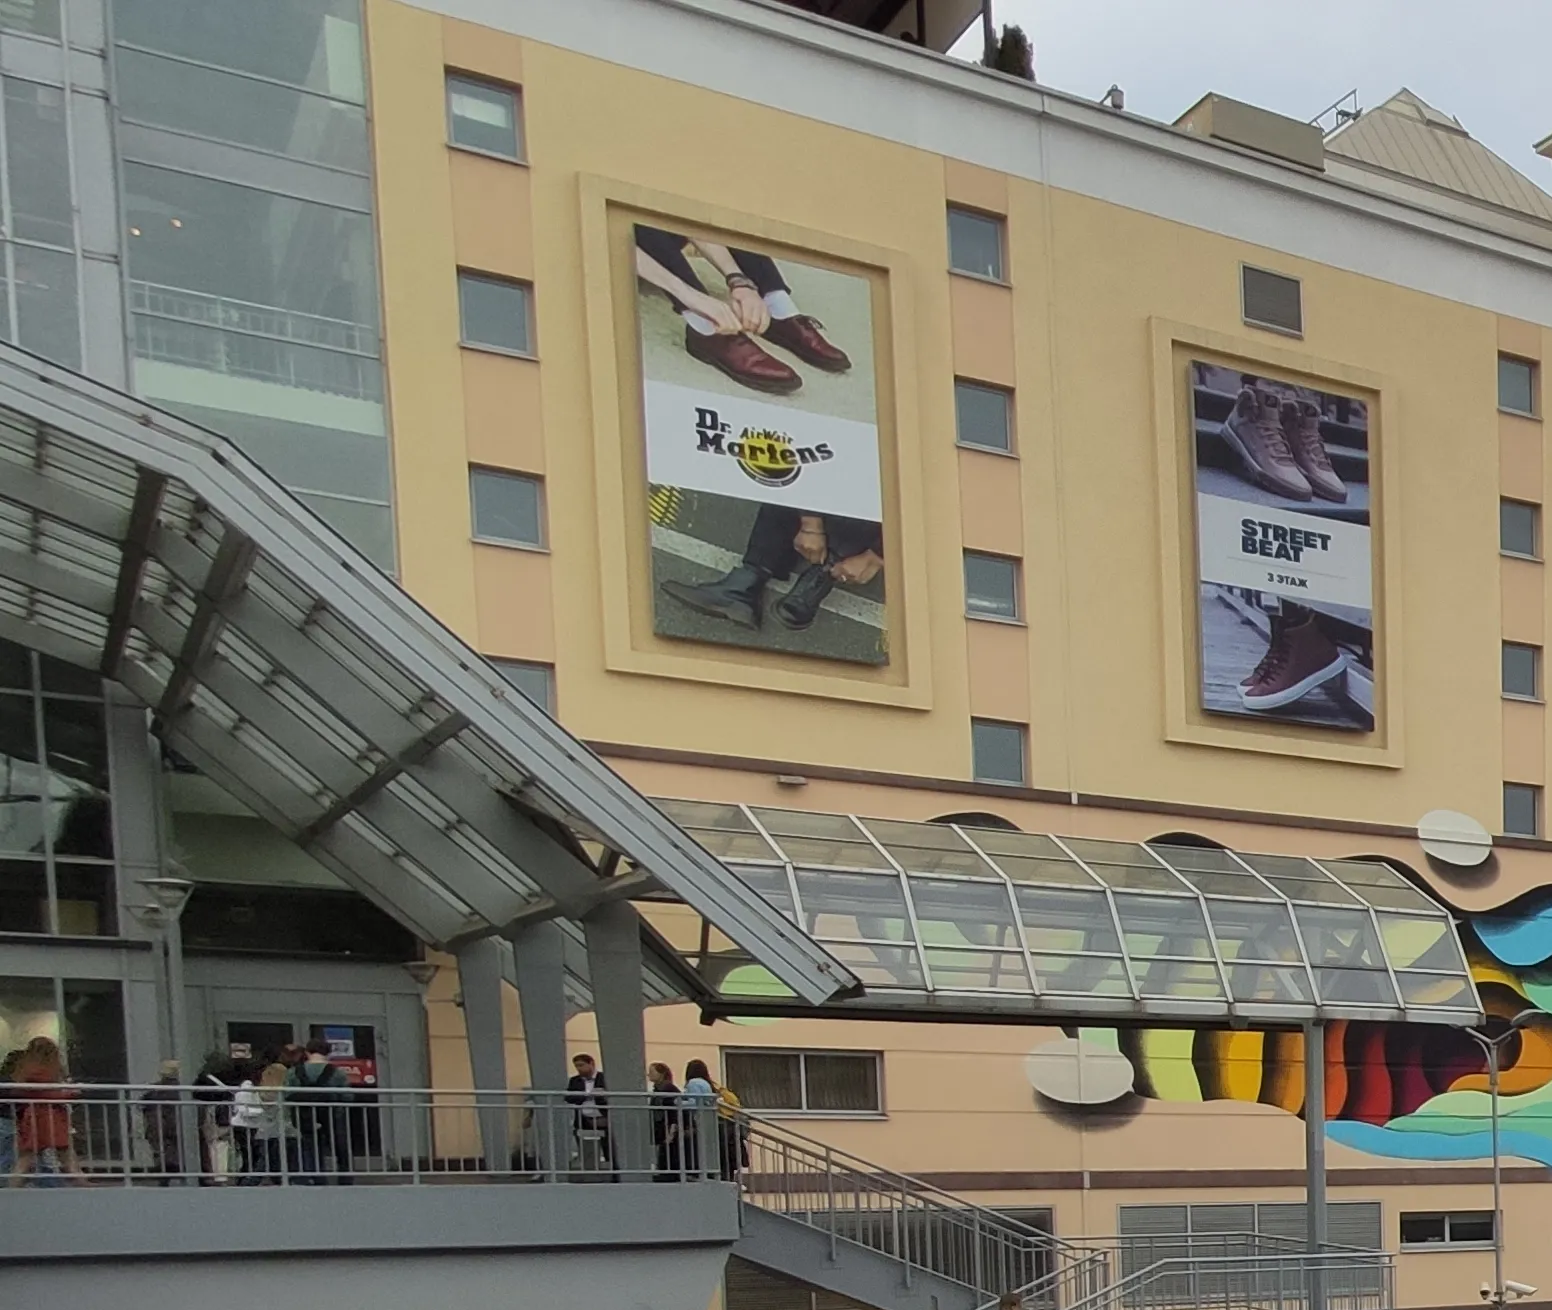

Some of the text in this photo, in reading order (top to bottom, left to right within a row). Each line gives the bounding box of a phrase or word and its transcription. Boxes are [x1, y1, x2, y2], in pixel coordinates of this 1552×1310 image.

[694, 406, 732, 434] Dr.
[695, 429, 835, 465] Martens
[740, 426, 794, 445] AirWair
[1241, 518, 1332, 551] STREET
[1241, 535, 1304, 563] BEAT
[1267, 572, 1309, 589] 3 ЭТАЖ
